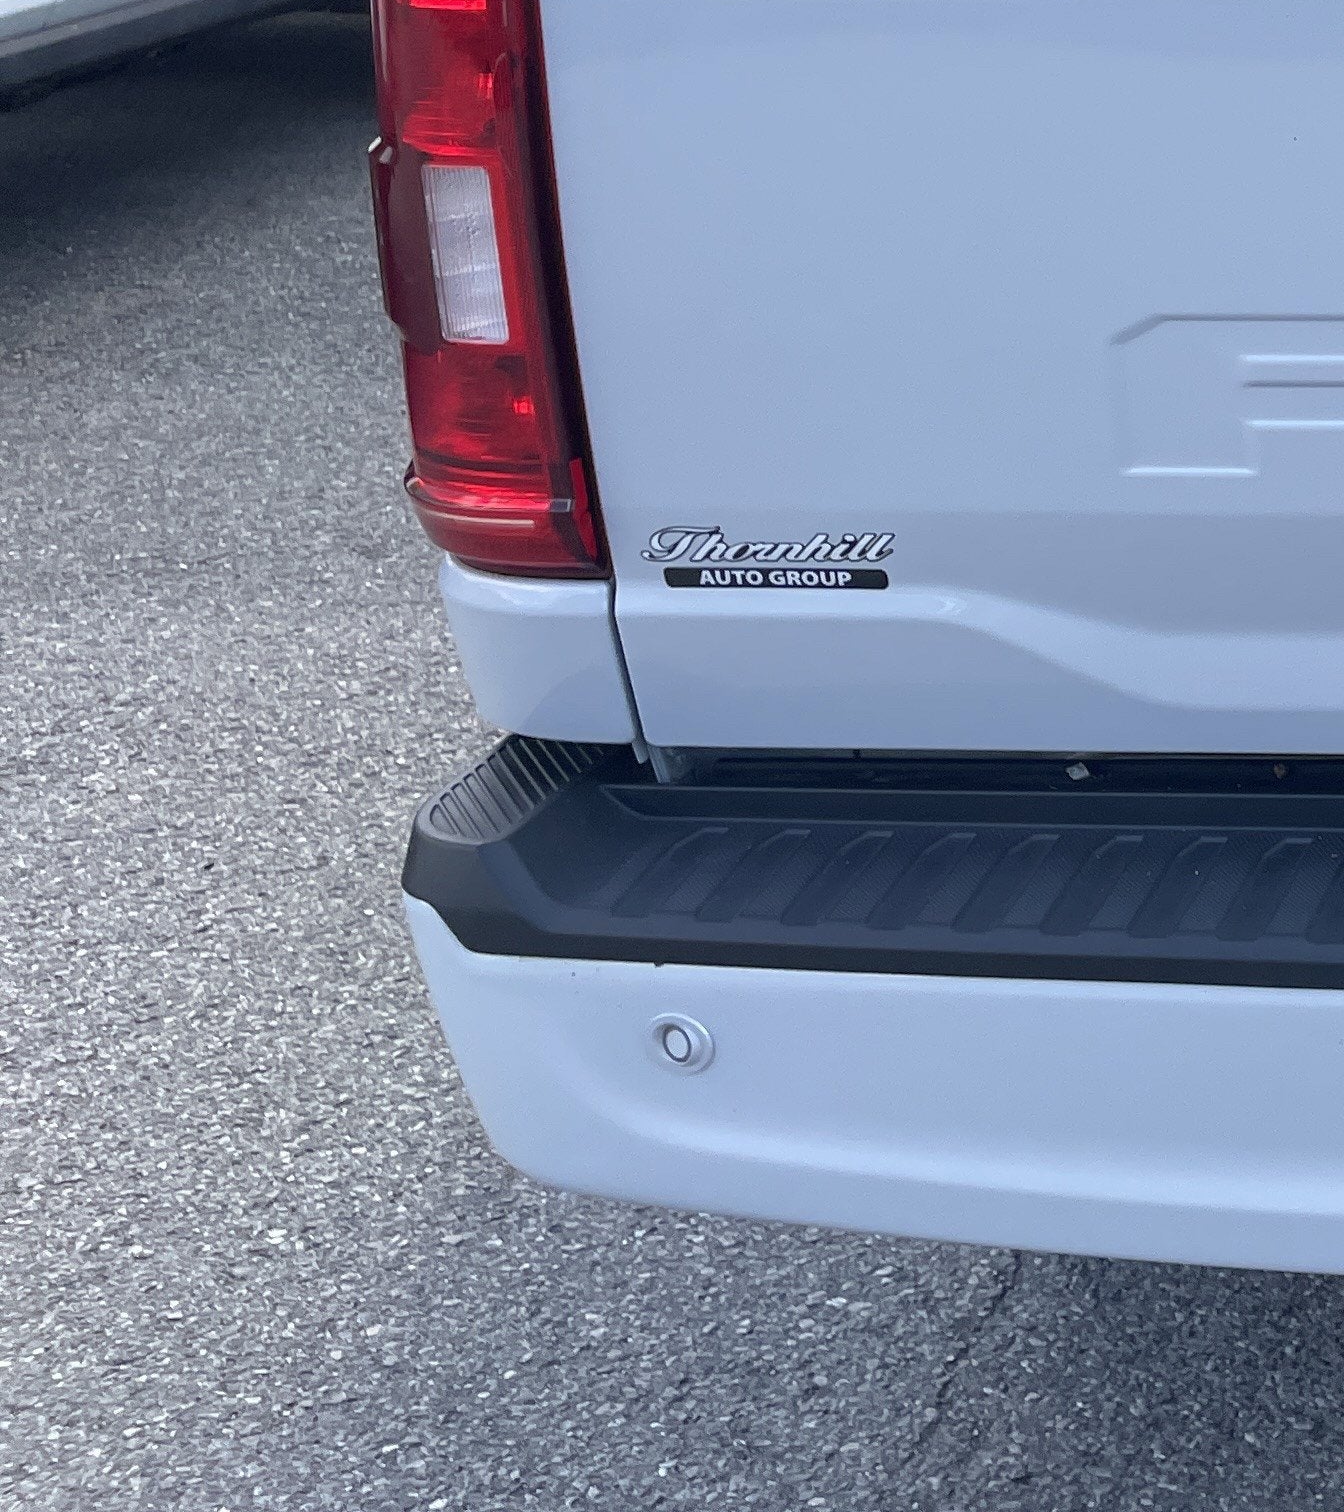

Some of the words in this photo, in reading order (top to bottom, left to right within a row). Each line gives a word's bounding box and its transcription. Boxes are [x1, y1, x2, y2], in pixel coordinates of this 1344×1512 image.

[640, 525, 896, 563] Thornhill
[699, 569, 763, 586] AUTO
[768, 570, 853, 587] GROUP
